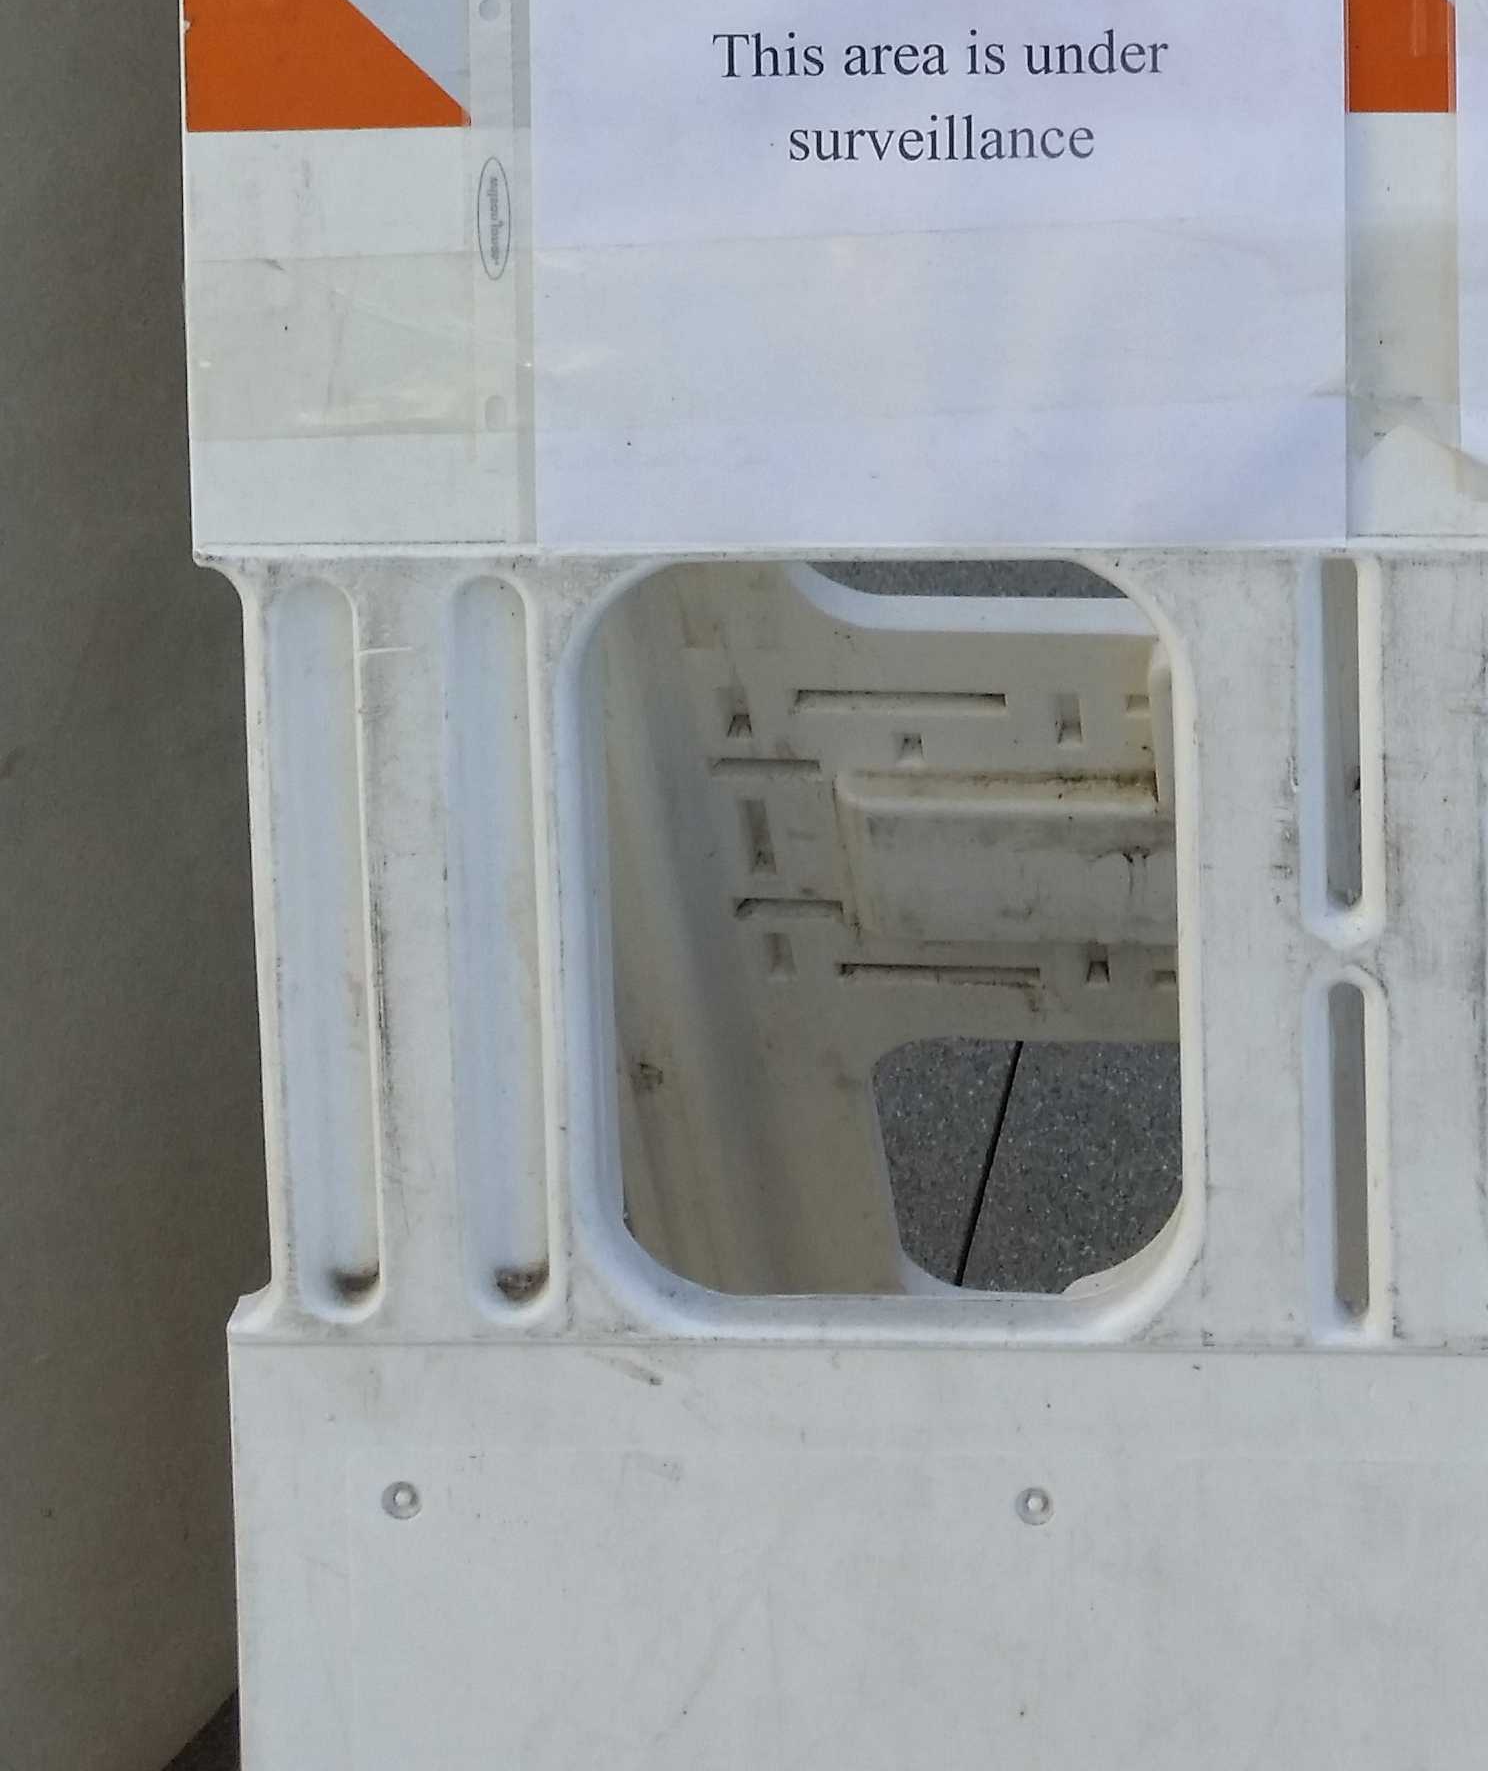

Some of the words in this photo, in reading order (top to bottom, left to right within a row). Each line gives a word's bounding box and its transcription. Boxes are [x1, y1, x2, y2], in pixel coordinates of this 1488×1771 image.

[713, 32, 824, 77] This
[844, 44, 948, 76] area
[967, 30, 1005, 75] is
[1024, 29, 1168, 74] under
[790, 114, 1094, 161] surveillance
